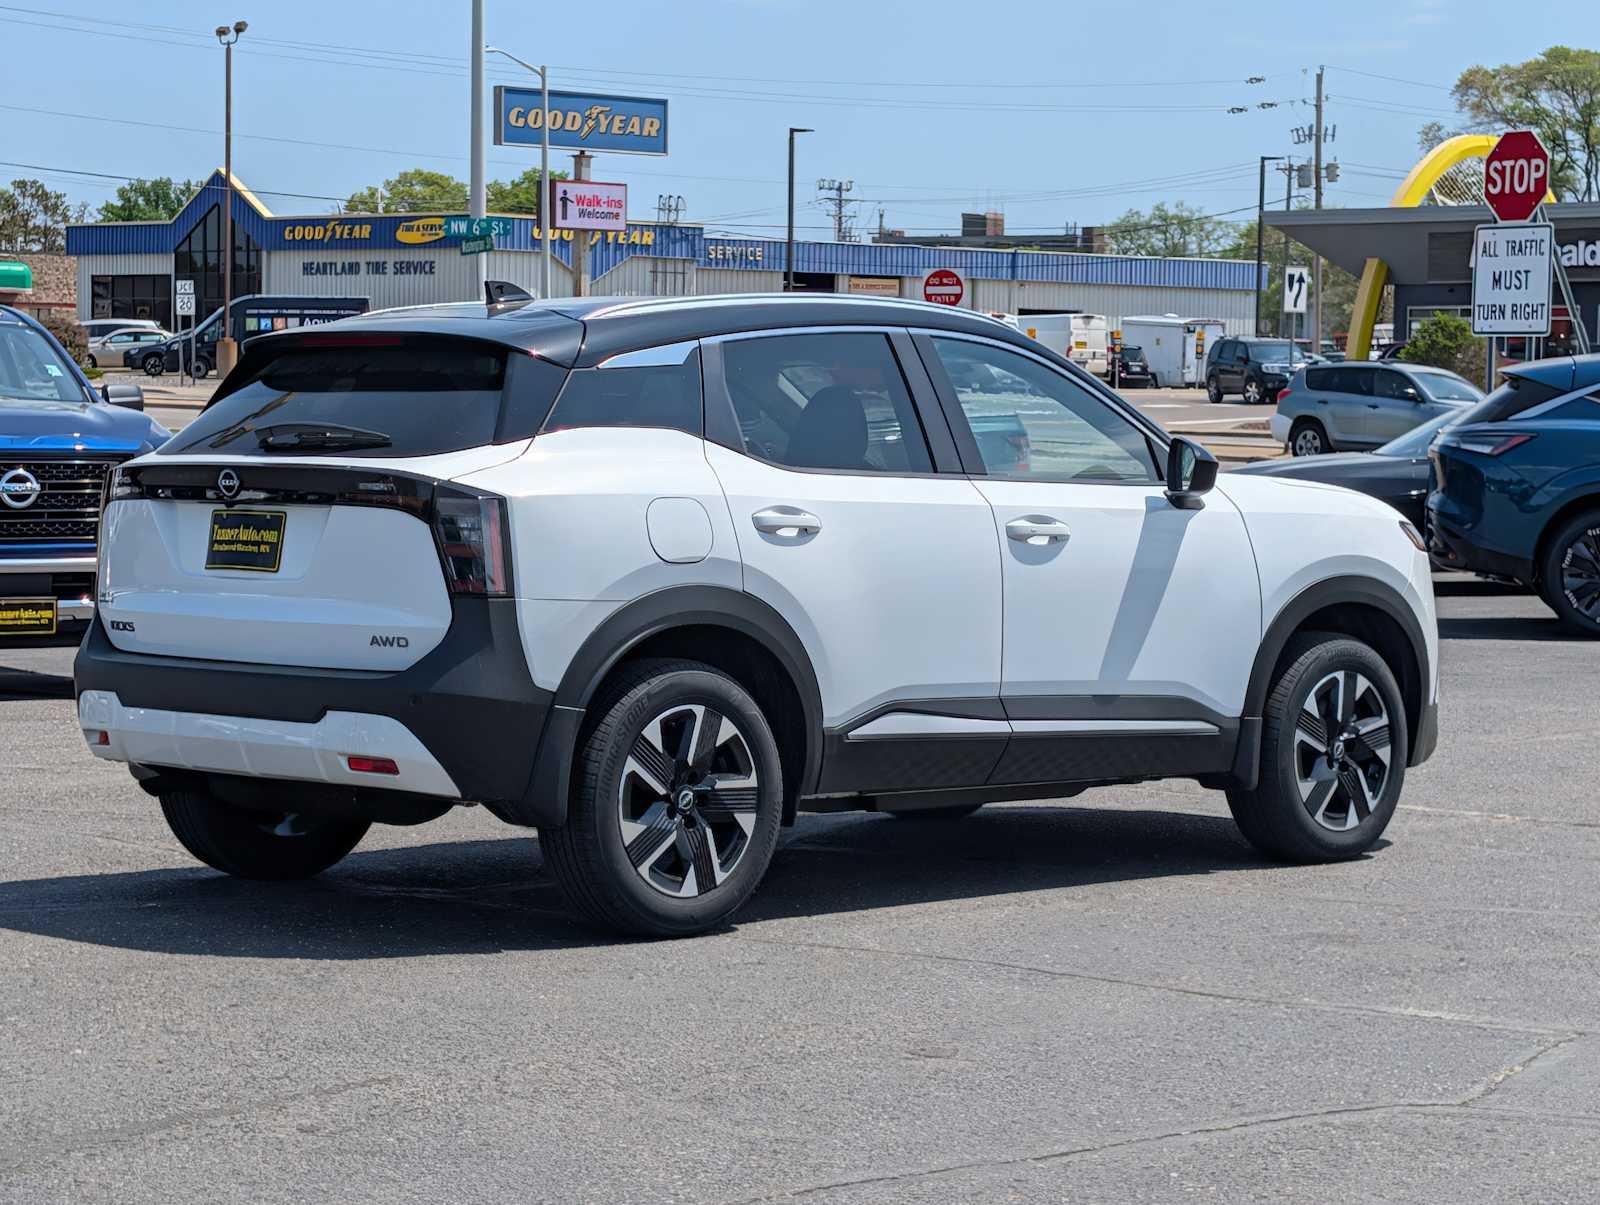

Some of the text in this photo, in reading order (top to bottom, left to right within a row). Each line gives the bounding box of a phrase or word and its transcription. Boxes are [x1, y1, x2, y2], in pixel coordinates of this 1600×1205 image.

[1487, 158, 1545, 194] STOP
[575, 193, 623, 209] Walk-ins
[578, 207, 621, 220] Welcome
[450, 220, 467, 234] NW
[491, 220, 503, 234] St
[707, 245, 763, 260] SERVICE
[1481, 239, 1545, 258] ALL TRAFFIC
[302, 260, 436, 276] HEARTLAND TIRE SERVICE
[929, 277, 957, 285] DO NOT
[1492, 270, 1531, 291] MUST
[179, 300, 192, 311] 20
[932, 295, 956, 303] ENTER
[1477, 303, 1545, 321] TURN RIGHT
[370, 635, 409, 648] AWD
